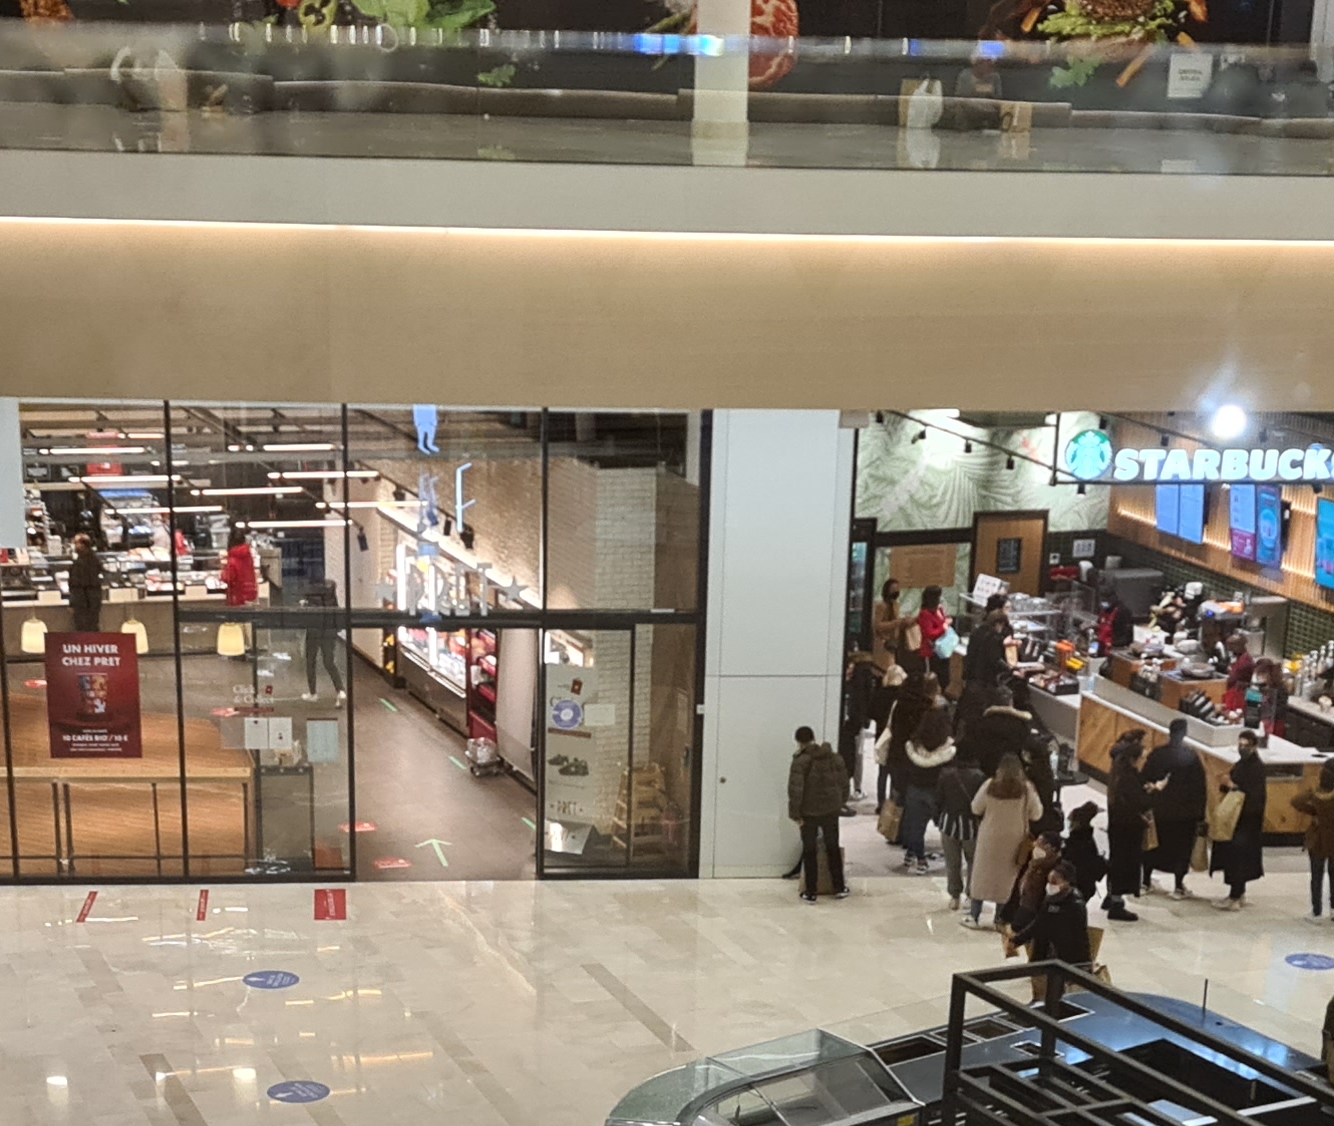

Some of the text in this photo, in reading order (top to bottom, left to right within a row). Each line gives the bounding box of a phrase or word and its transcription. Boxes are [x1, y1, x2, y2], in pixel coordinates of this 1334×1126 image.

[63, 644, 119, 654] UN HIVER
[62, 657, 121, 666] CHEZ PRET
